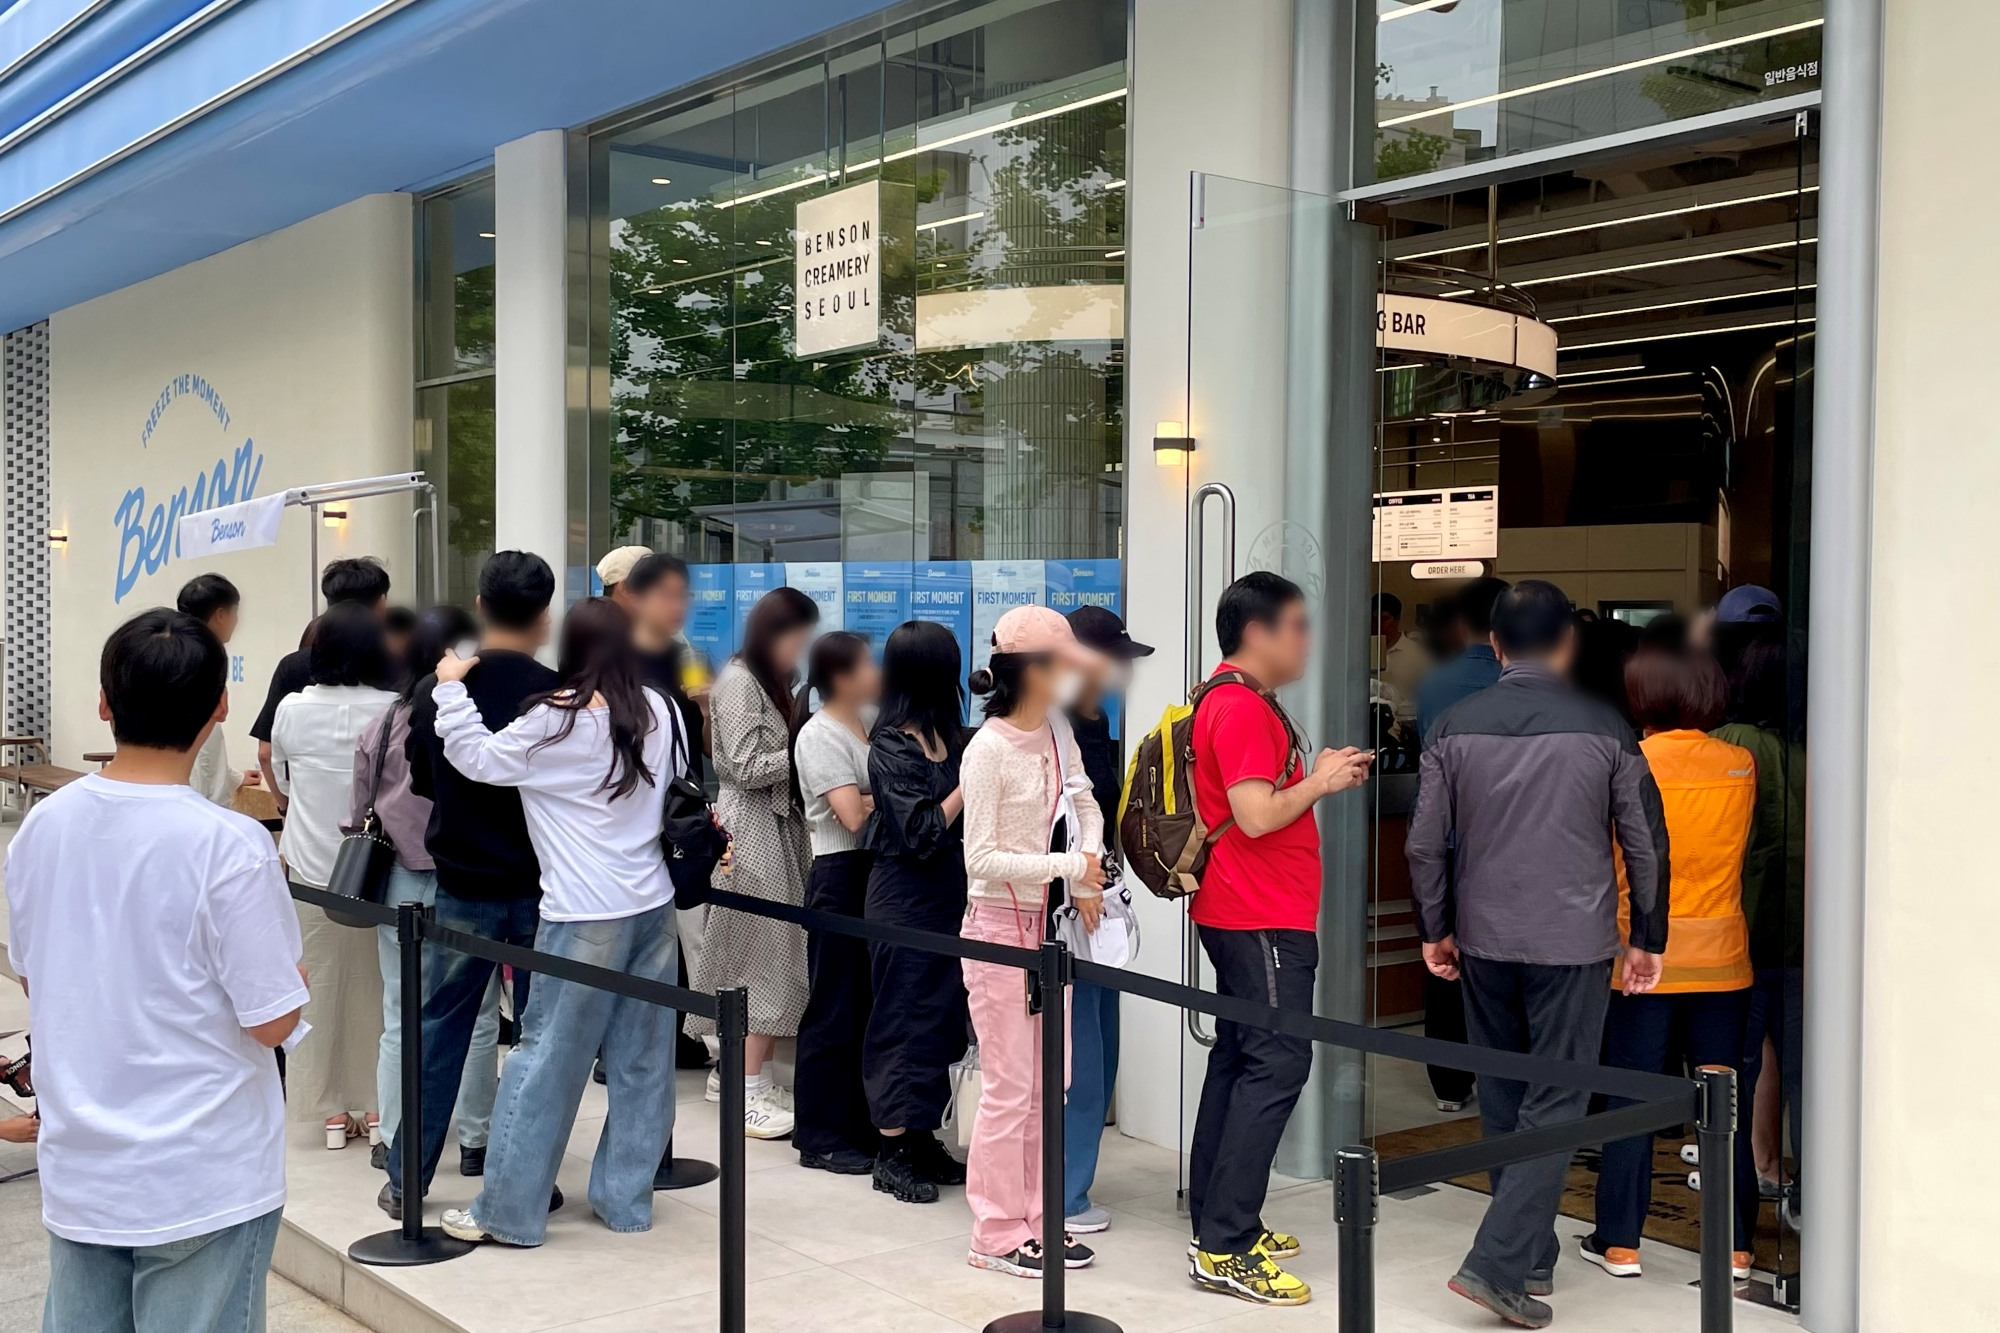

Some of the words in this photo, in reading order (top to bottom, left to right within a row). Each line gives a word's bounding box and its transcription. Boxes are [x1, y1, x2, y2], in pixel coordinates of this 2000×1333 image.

[1764, 61, 1819, 86] 일반음식점
[805, 220, 871, 257] BENSON
[805, 253, 871, 288] CREAMERY
[805, 287, 871, 320] SEOUL
[1392, 312, 1427, 336] BAR
[141, 384, 171, 449] FREEZE
[173, 373, 190, 398] THE
[192, 373, 231, 432] MOMENT
[210, 517, 246, 544] Benson
[1428, 566, 1449, 575] ORDER
[1450, 565, 1466, 574] HERE
[736, 590, 753, 601] FIRST
[847, 591, 866, 603] FIRST
[867, 591, 897, 603] MOMENT
[910, 591, 930, 604] FIRST
[931, 591, 964, 604] MOMENT
[977, 592, 1000, 605] FIRST
[1002, 592, 1037, 605] MOMENT
[1051, 592, 1076, 606] FIRST
[1078, 592, 1116, 606] MOMENT
[232, 655, 244, 682] BE
